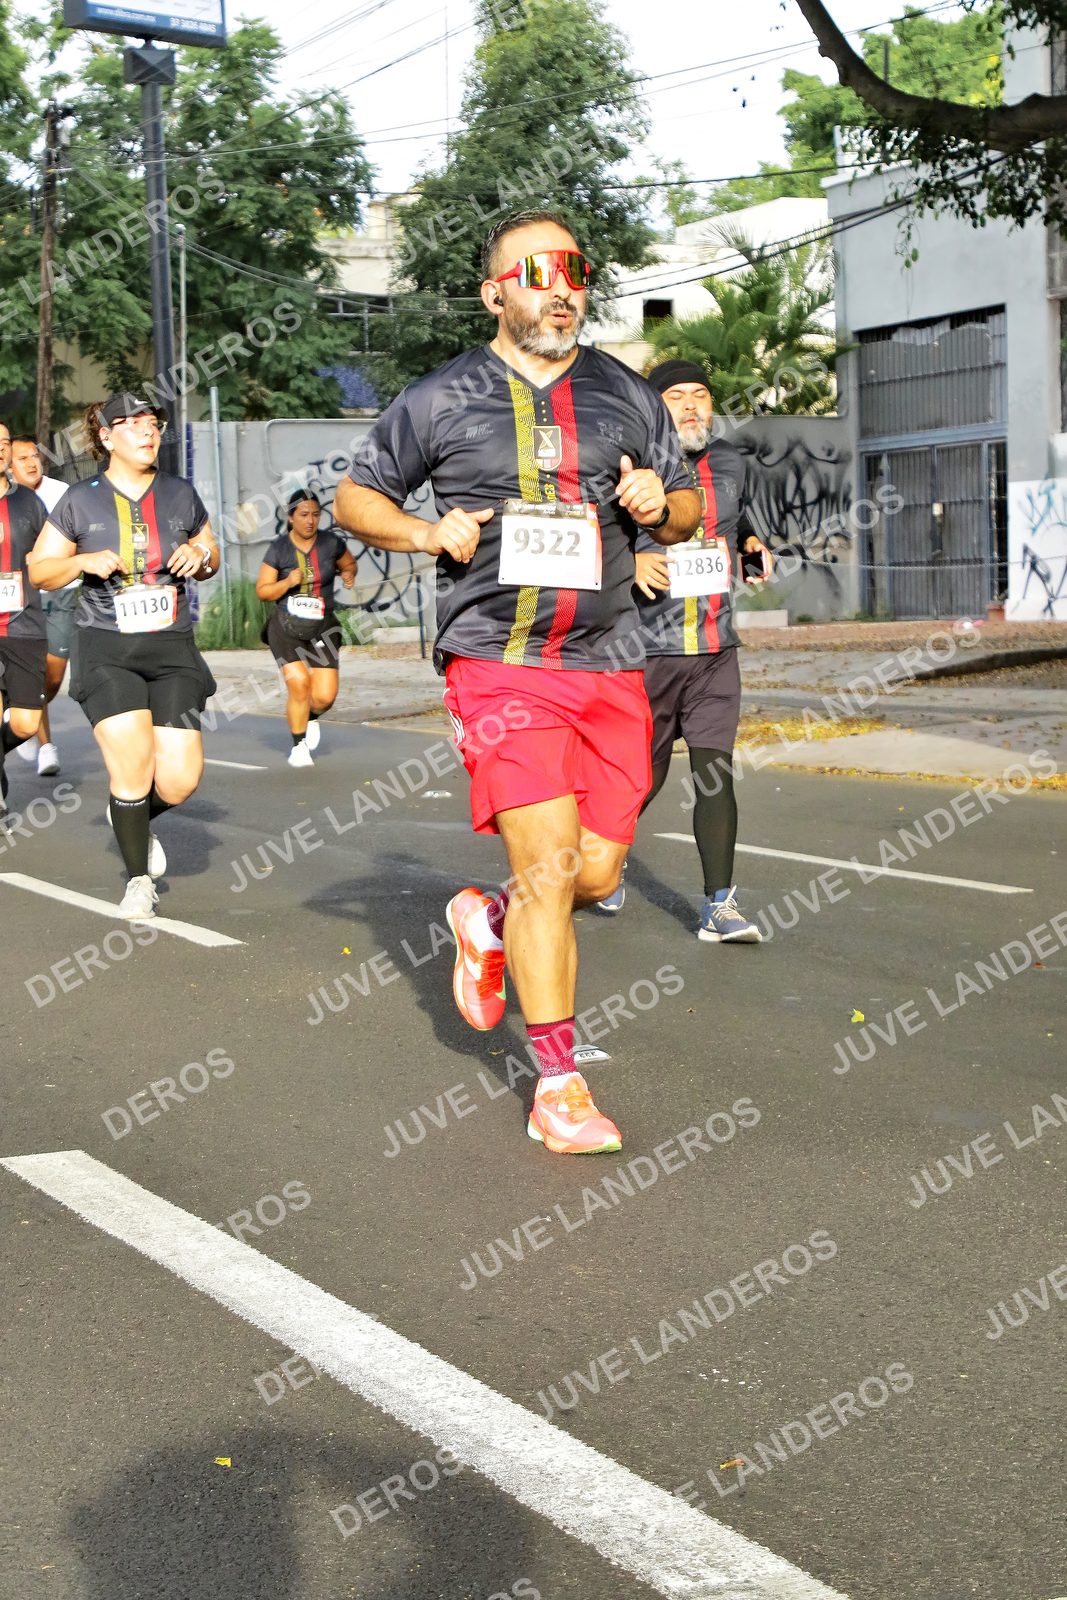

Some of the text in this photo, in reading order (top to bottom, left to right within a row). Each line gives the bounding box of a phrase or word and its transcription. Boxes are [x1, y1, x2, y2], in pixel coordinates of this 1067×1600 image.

[514, 527, 581, 557] 9322
[675, 556, 724, 577] 12836
[120, 596, 169, 617] 11130
